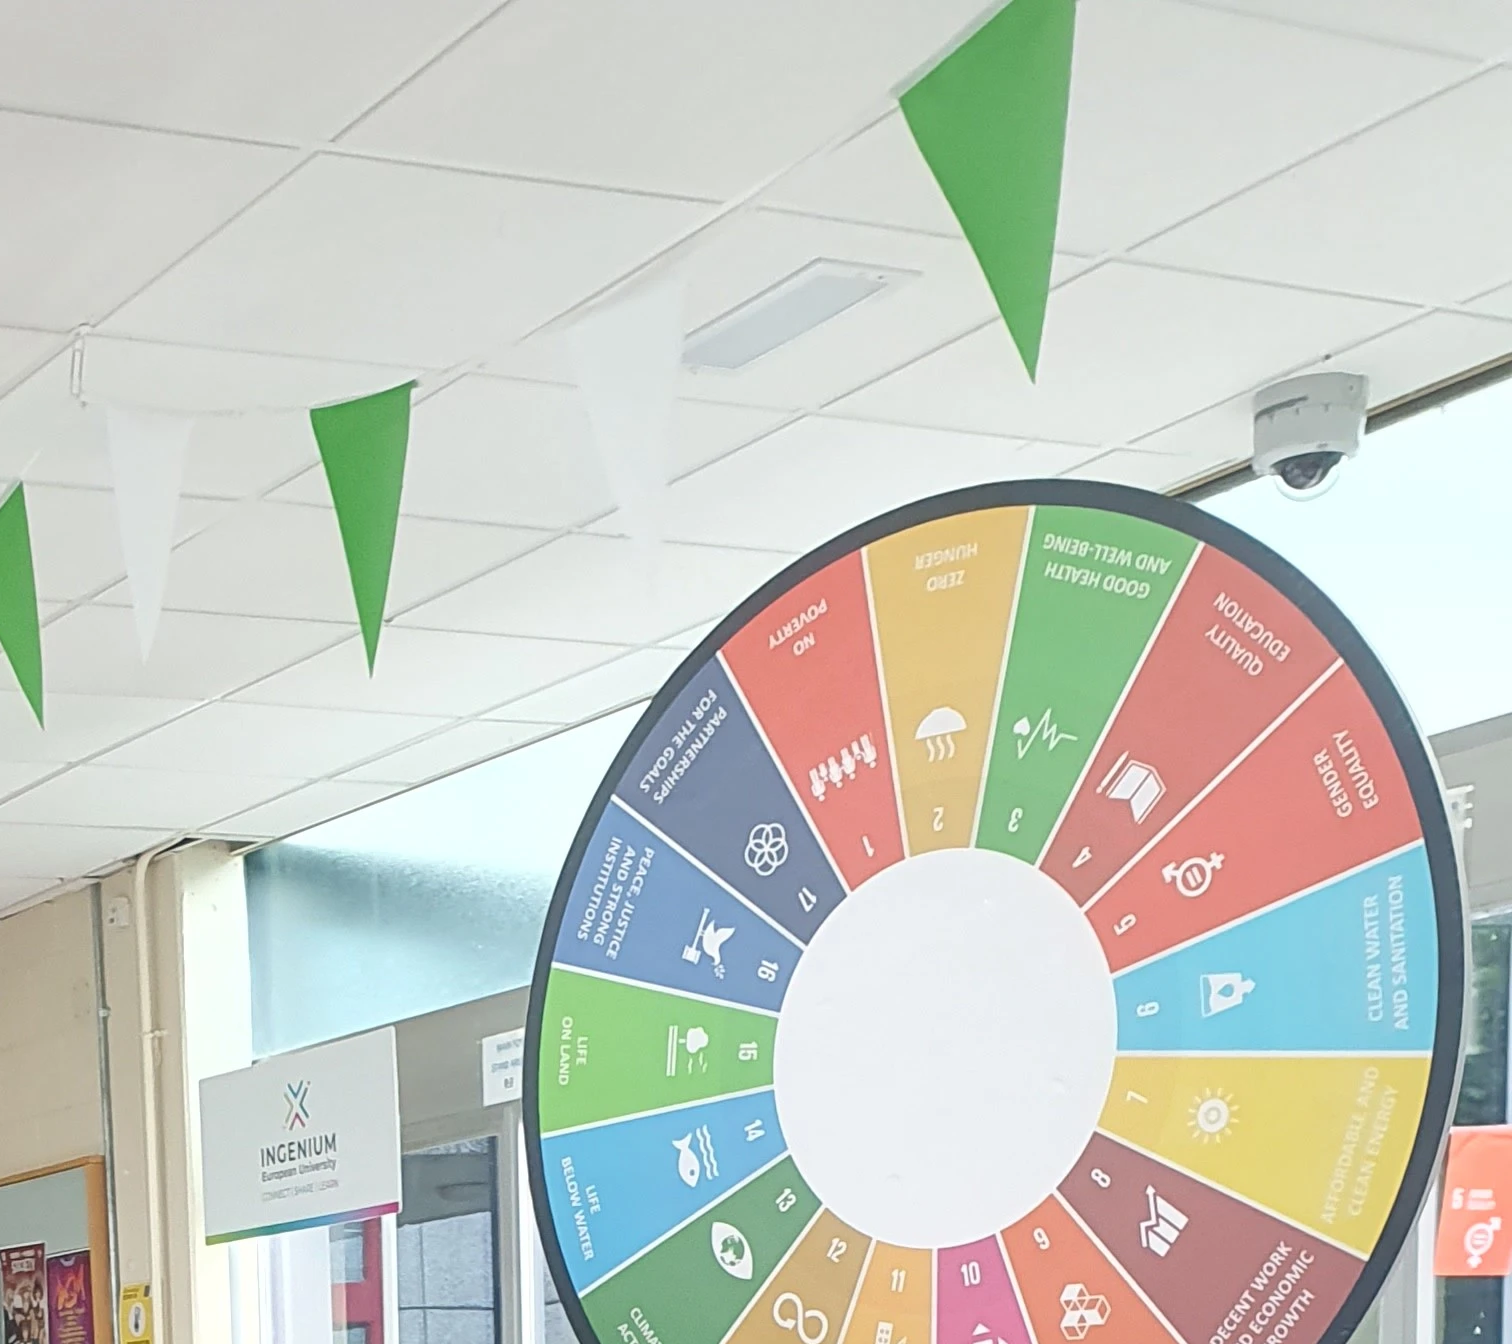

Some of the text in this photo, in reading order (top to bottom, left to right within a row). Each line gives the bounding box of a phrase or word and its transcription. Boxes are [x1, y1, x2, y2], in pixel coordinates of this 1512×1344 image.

[914, 542, 979, 570] HUNGER
[1043, 533, 1173, 576] AND WELL-BEING
[926, 570, 966, 592] ZERO
[1044, 561, 1151, 600] GOOD HEALTH
[768, 598, 828, 650] POVERTY
[1213, 591, 1292, 663] EDUCATION
[792, 632, 817, 656] NO
[1205, 623, 1265, 677] QUALITY
[639, 688, 719, 794] FOR THE GOALS
[653, 706, 728, 804] PARTNERSHIPS
[1312, 747, 1354, 819] GENDER
[1332, 730, 1380, 811] EQUALITY
[933, 806, 945, 832] 2
[1007, 807, 1024, 833] 3
[862, 836, 875, 858] 1
[1072, 846, 1093, 869] 4
[576, 836, 624, 942] INSTITUTIONS
[593, 844, 637, 947] AND STRONG
[605, 846, 656, 961] PEACE, JUSTICE
[798, 886, 818, 913] 17
[1113, 912, 1138, 937] 5
[1362, 893, 1384, 1022] CLEAN WATER
[1387, 874, 1410, 1031] AND SANITATION
[757, 959, 780, 984] 16
[1136, 1000, 1160, 1018] 6
[558, 1015, 574, 1086] ON LAND
[575, 1035, 589, 1066] LIFE
[738, 1040, 759, 1062] 15
[1125, 1090, 1149, 1105] 7
[744, 1119, 766, 1143] 14
[1319, 1064, 1380, 1226] AFFORDABLE AND
[260, 1132, 338, 1168] INGENIUM
[1347, 1085, 1400, 1218] CLEAN ENERGY
[261, 1158, 338, 1183] European University
[1090, 1168, 1112, 1189] 8
[561, 1155, 595, 1262] BELOW WATER
[584, 1184, 602, 1215] LIFE
[775, 1188, 797, 1213] 13
[826, 1237, 848, 1263] 12
[1033, 1227, 1050, 1250] 9
[891, 1268, 907, 1293] 11
[960, 1261, 981, 1287] 10
[1249, 1240, 1294, 1296] WORK
[1247, 1250, 1316, 1334] ECONOMIC
